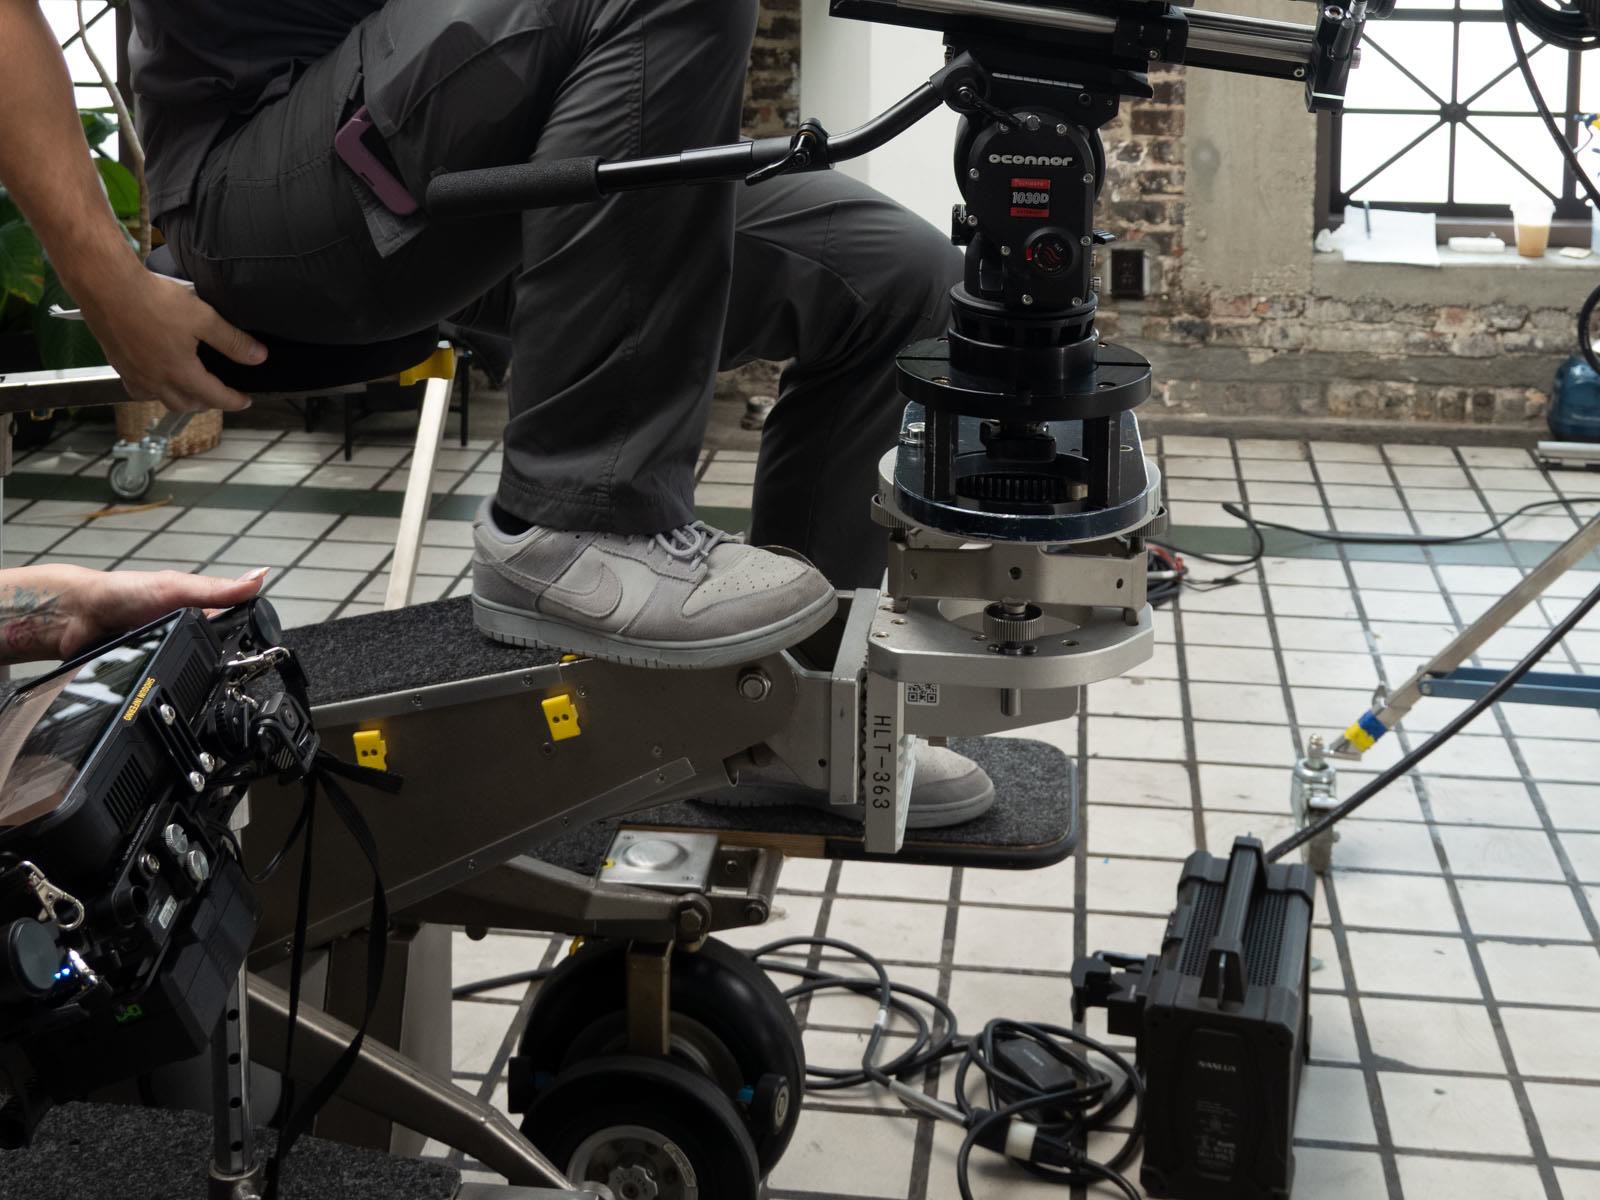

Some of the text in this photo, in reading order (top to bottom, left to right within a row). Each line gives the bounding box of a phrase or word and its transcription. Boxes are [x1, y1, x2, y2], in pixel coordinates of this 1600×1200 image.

[988, 154, 1073, 167] oconnor
[1012, 192, 1050, 205] 1030D
[123, 677, 156, 721] SHOGUN INFERNO
[873, 715, 891, 809] HLT-363
